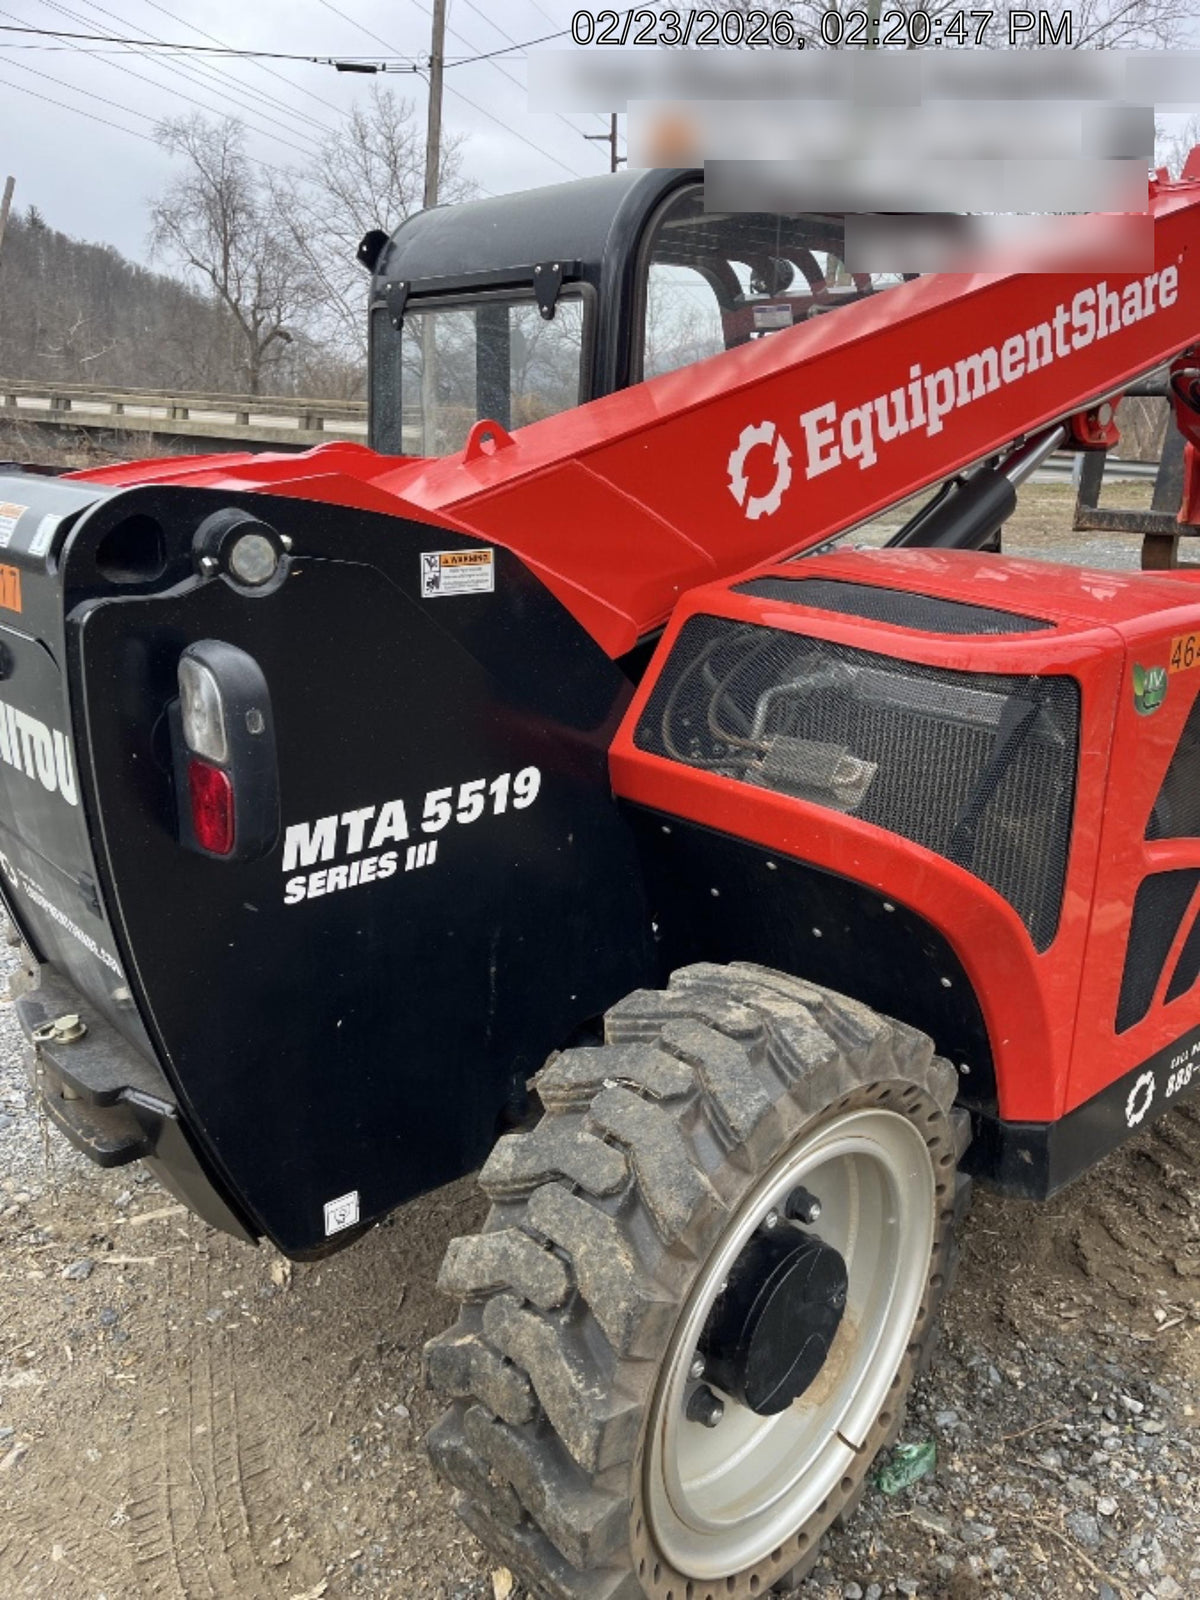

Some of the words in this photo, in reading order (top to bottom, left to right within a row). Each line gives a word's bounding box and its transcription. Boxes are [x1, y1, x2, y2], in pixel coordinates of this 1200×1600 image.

[799, 264, 1179, 480] EquipmentShare
[1171, 635, 1200, 669] 46
[281, 799, 410, 872] MTA
[421, 765, 541, 833] 5519
[283, 850, 399, 905] SERIES
[405, 840, 439, 871] III
